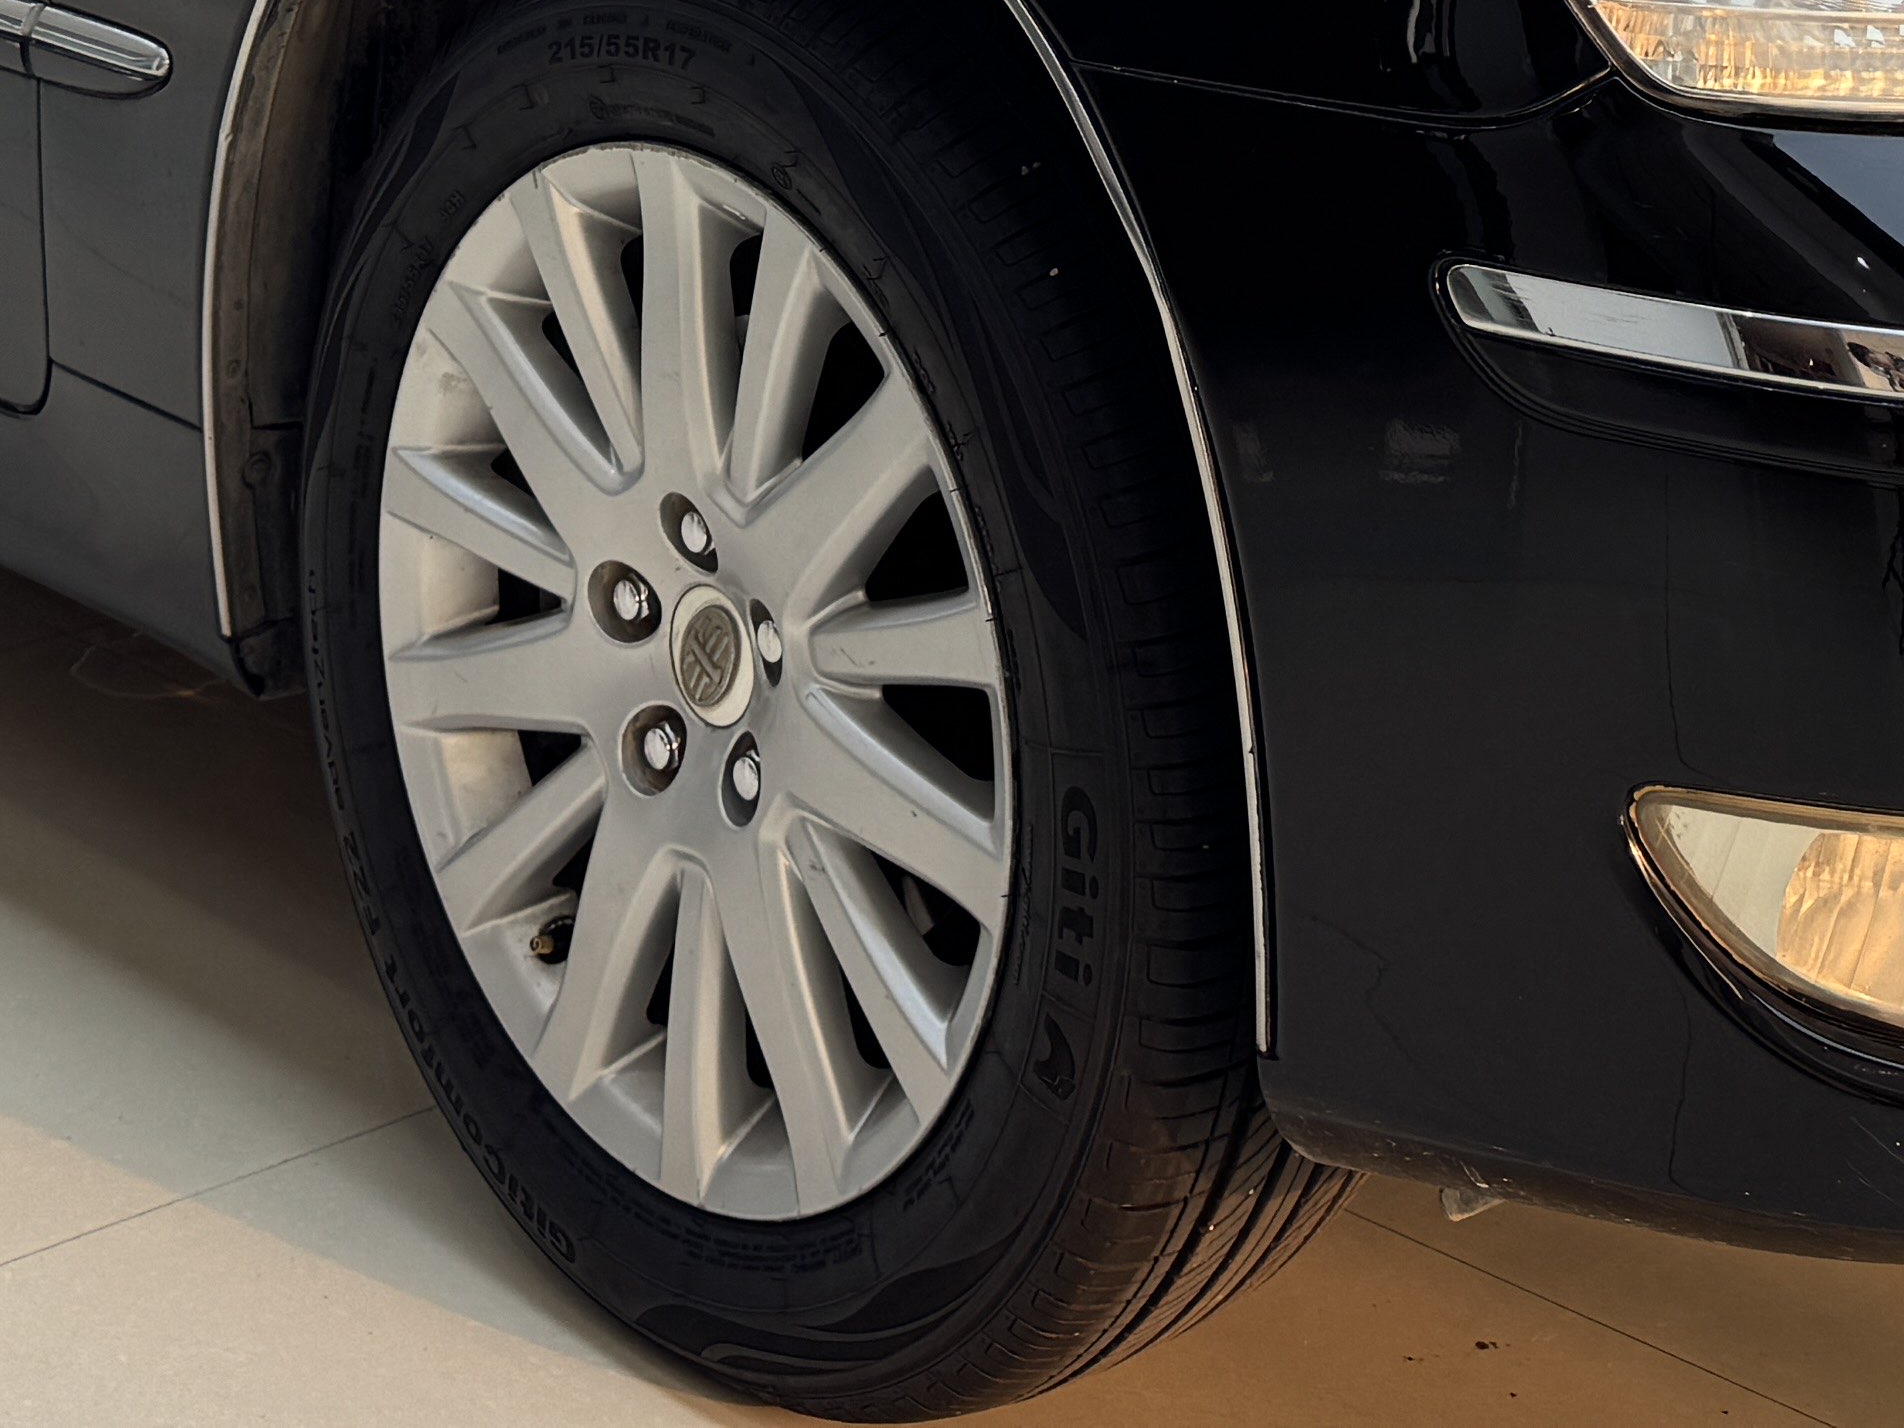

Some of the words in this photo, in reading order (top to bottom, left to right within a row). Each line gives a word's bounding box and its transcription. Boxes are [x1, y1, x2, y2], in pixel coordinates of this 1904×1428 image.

[547, 33, 696, 71] 215/55R17
[1054, 785, 1099, 986] Giti
[383, 954, 577, 1266] GitiComfort
